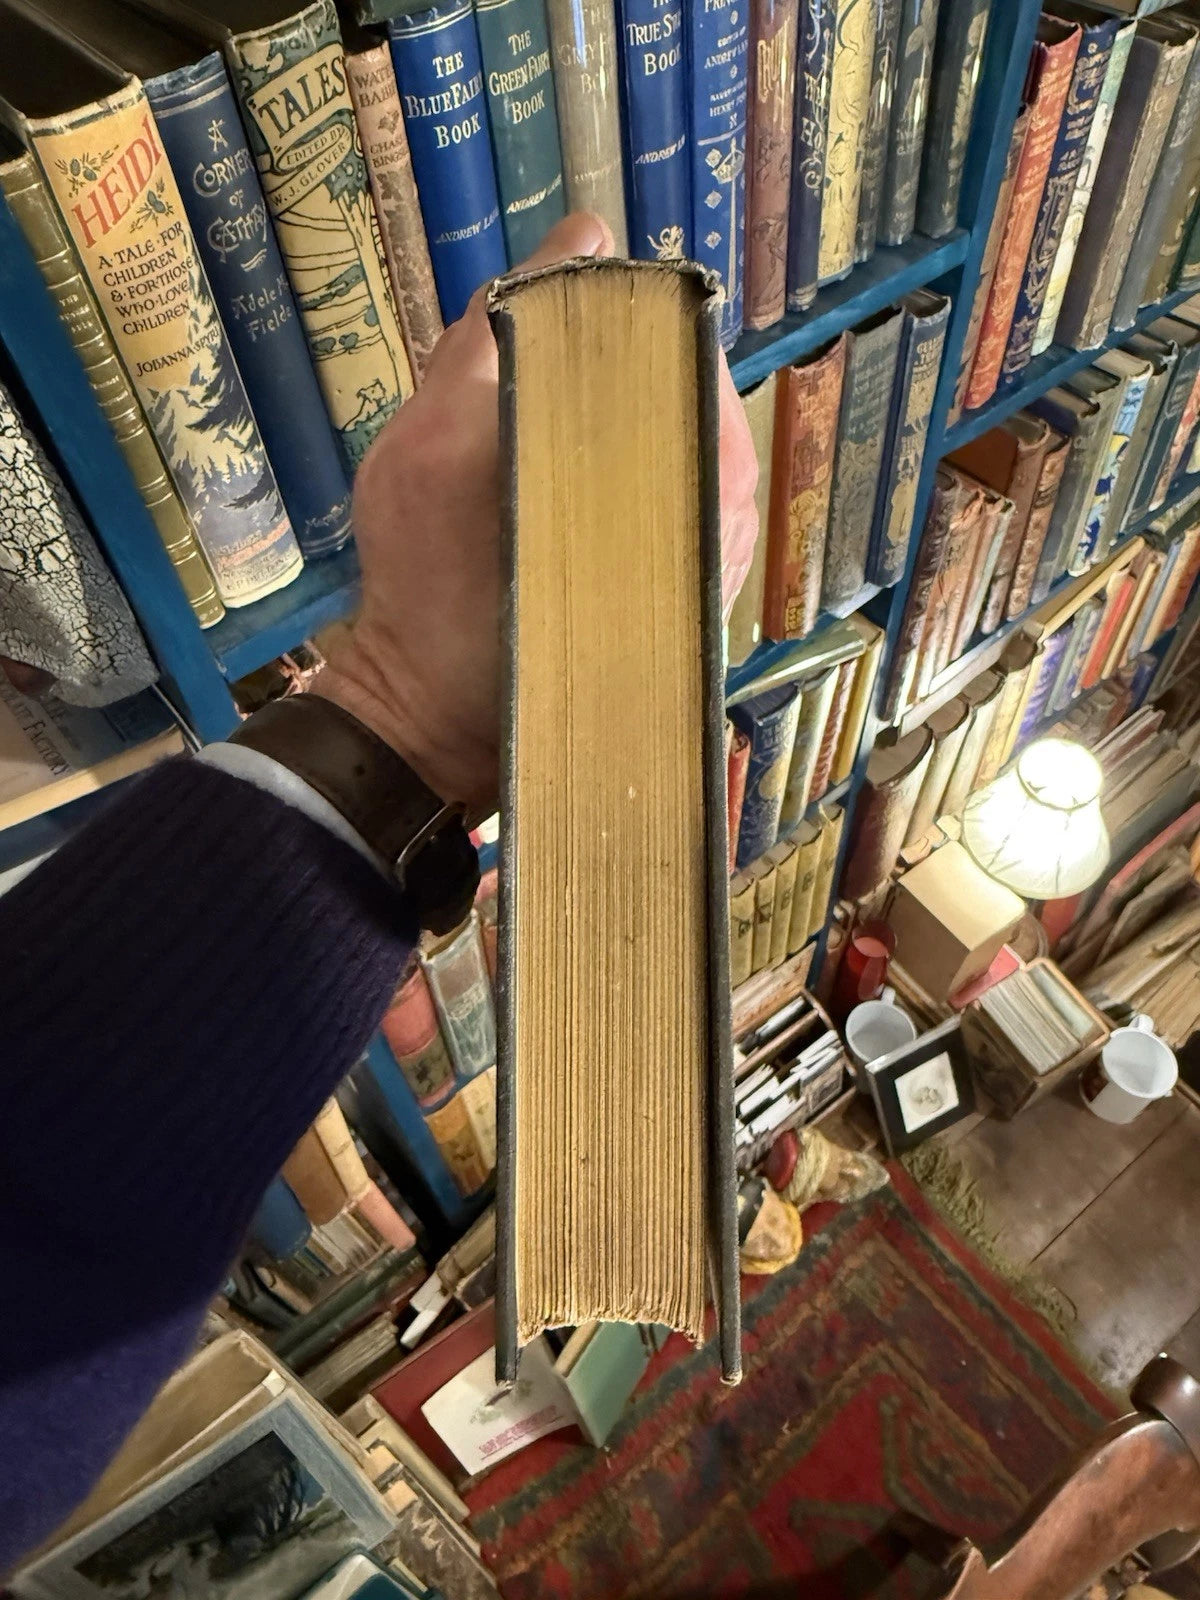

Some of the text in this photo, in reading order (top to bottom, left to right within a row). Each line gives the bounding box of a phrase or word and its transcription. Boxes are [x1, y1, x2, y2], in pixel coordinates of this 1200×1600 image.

[507, 29, 532, 56] THE
[627, 21, 661, 46] TRUE
[432, 51, 465, 79] THE
[489, 63, 529, 96] GREEN
[257, 55, 346, 139] TALES
[405, 90, 452, 119] BLUE
[510, 89, 546, 125] BOOK
[207, 118, 229, 153] A
[433, 112, 481, 149] BOOK
[285, 133, 328, 165] EDITED
[300, 141, 347, 187] GLOVER
[635, 143, 677, 165] ANDREW
[71, 114, 163, 249] HEIDI
[193, 147, 256, 198] CORNER
[229, 188, 244, 210] OF
[506, 187, 547, 214] ANDREW
[207, 201, 267, 264] CATHAY
[434, 219, 481, 244] ANDREW
[103, 247, 179, 287] CHILDREN
[114, 239, 155, 265] TALE
[127, 279, 157, 300] FOR
[157, 256, 194, 287] THOSE
[115, 299, 155, 319] WHO
[157, 279, 189, 306] LOVE
[232, 287, 277, 320] Adele
[122, 298, 191, 335] CHILDREN
